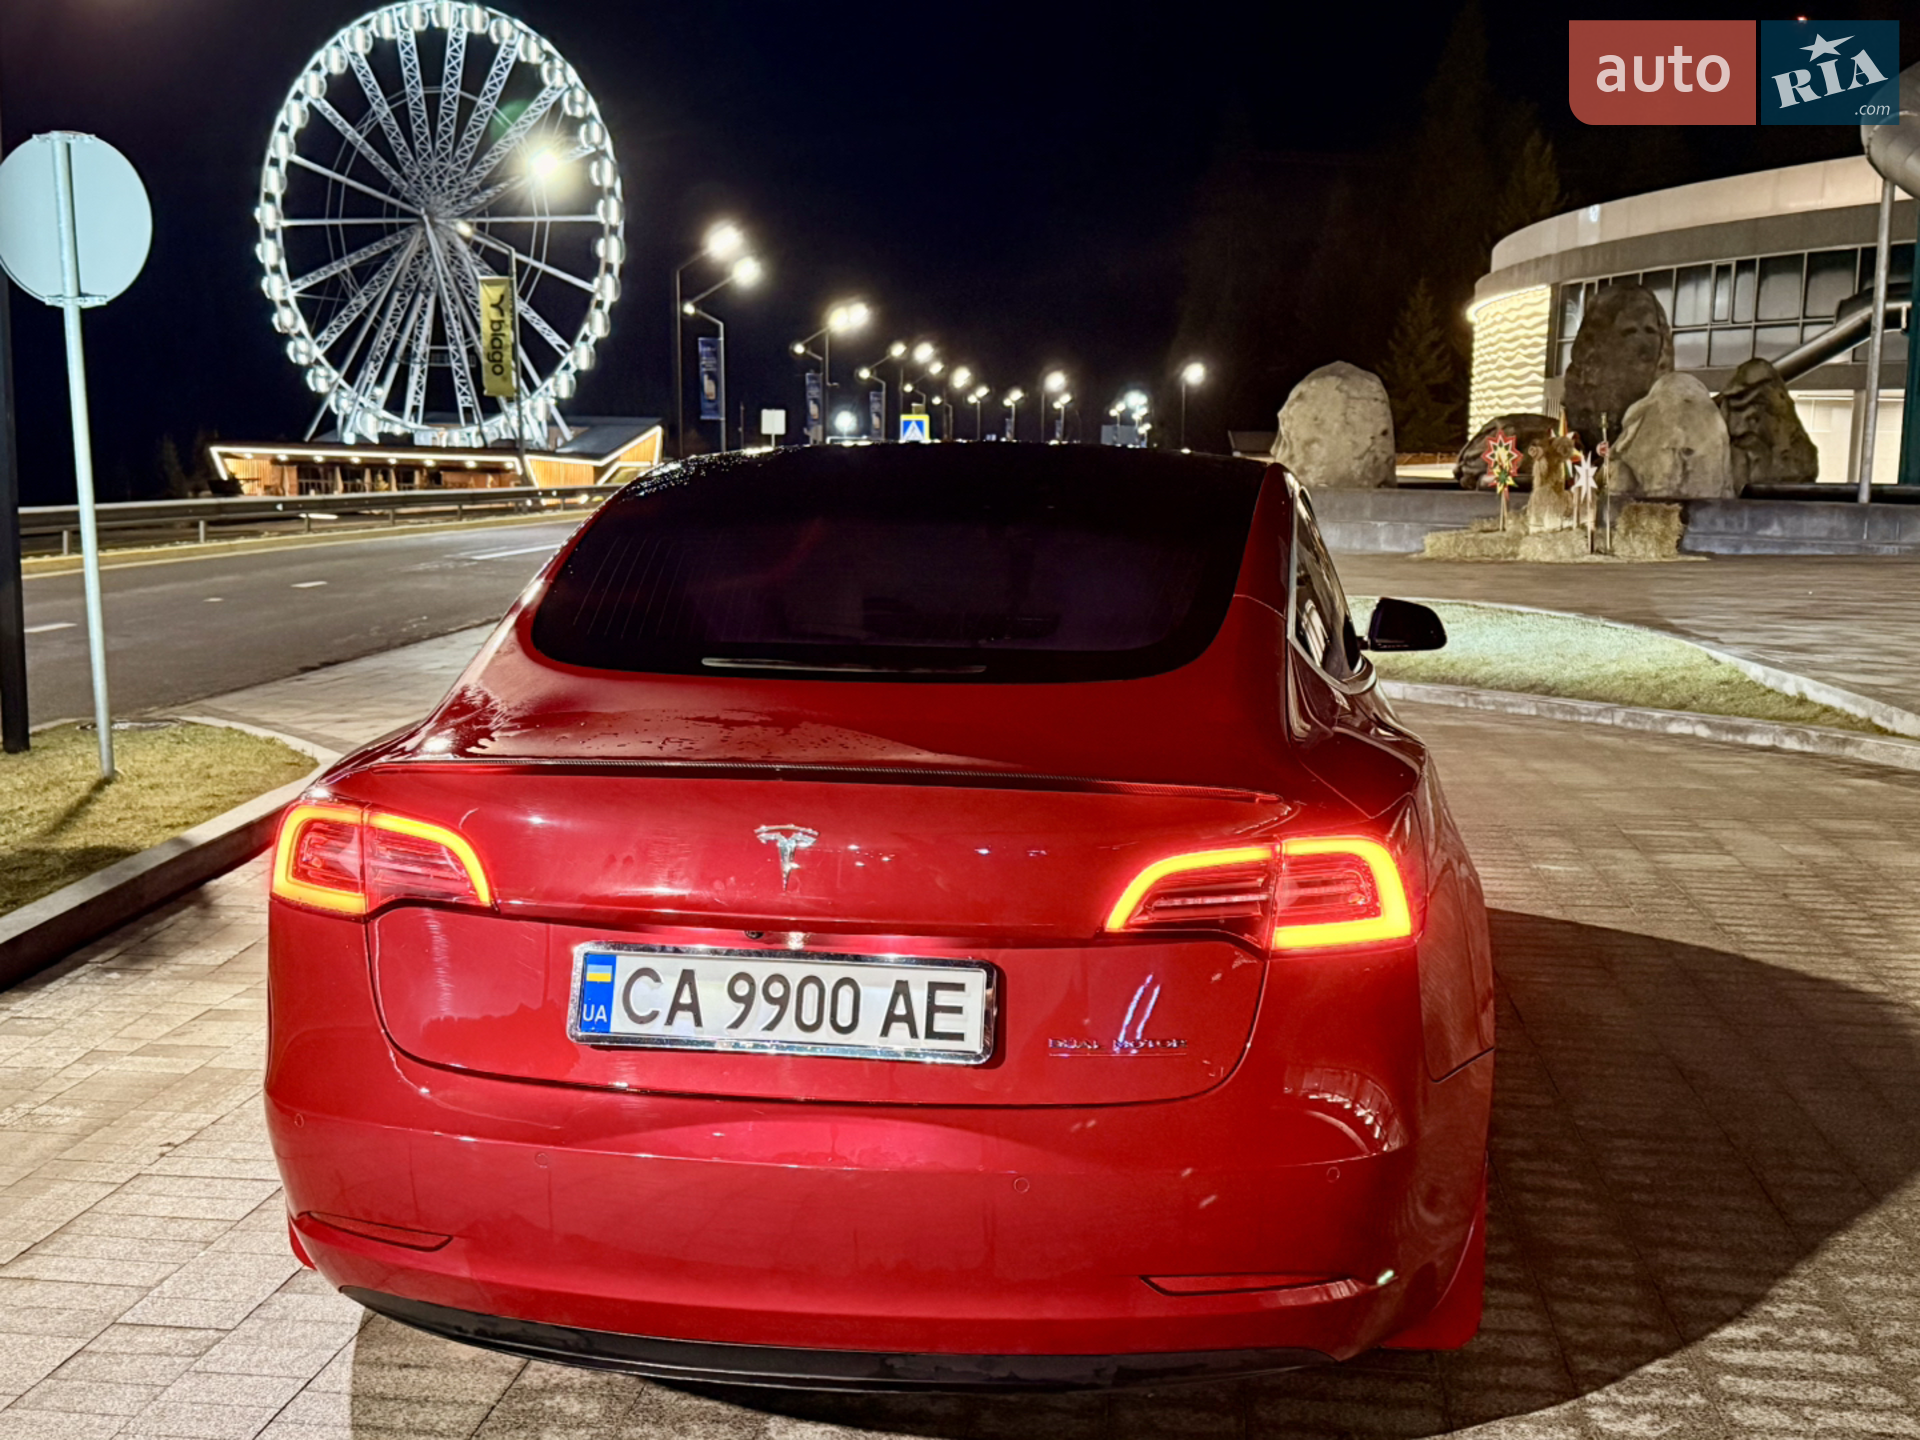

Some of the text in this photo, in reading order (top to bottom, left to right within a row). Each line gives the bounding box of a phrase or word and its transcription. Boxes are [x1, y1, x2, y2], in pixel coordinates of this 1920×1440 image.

[487, 320, 505, 376] blago
[582, 1003, 607, 1022] UA
[622, 967, 966, 1041] CA 9900 AE
